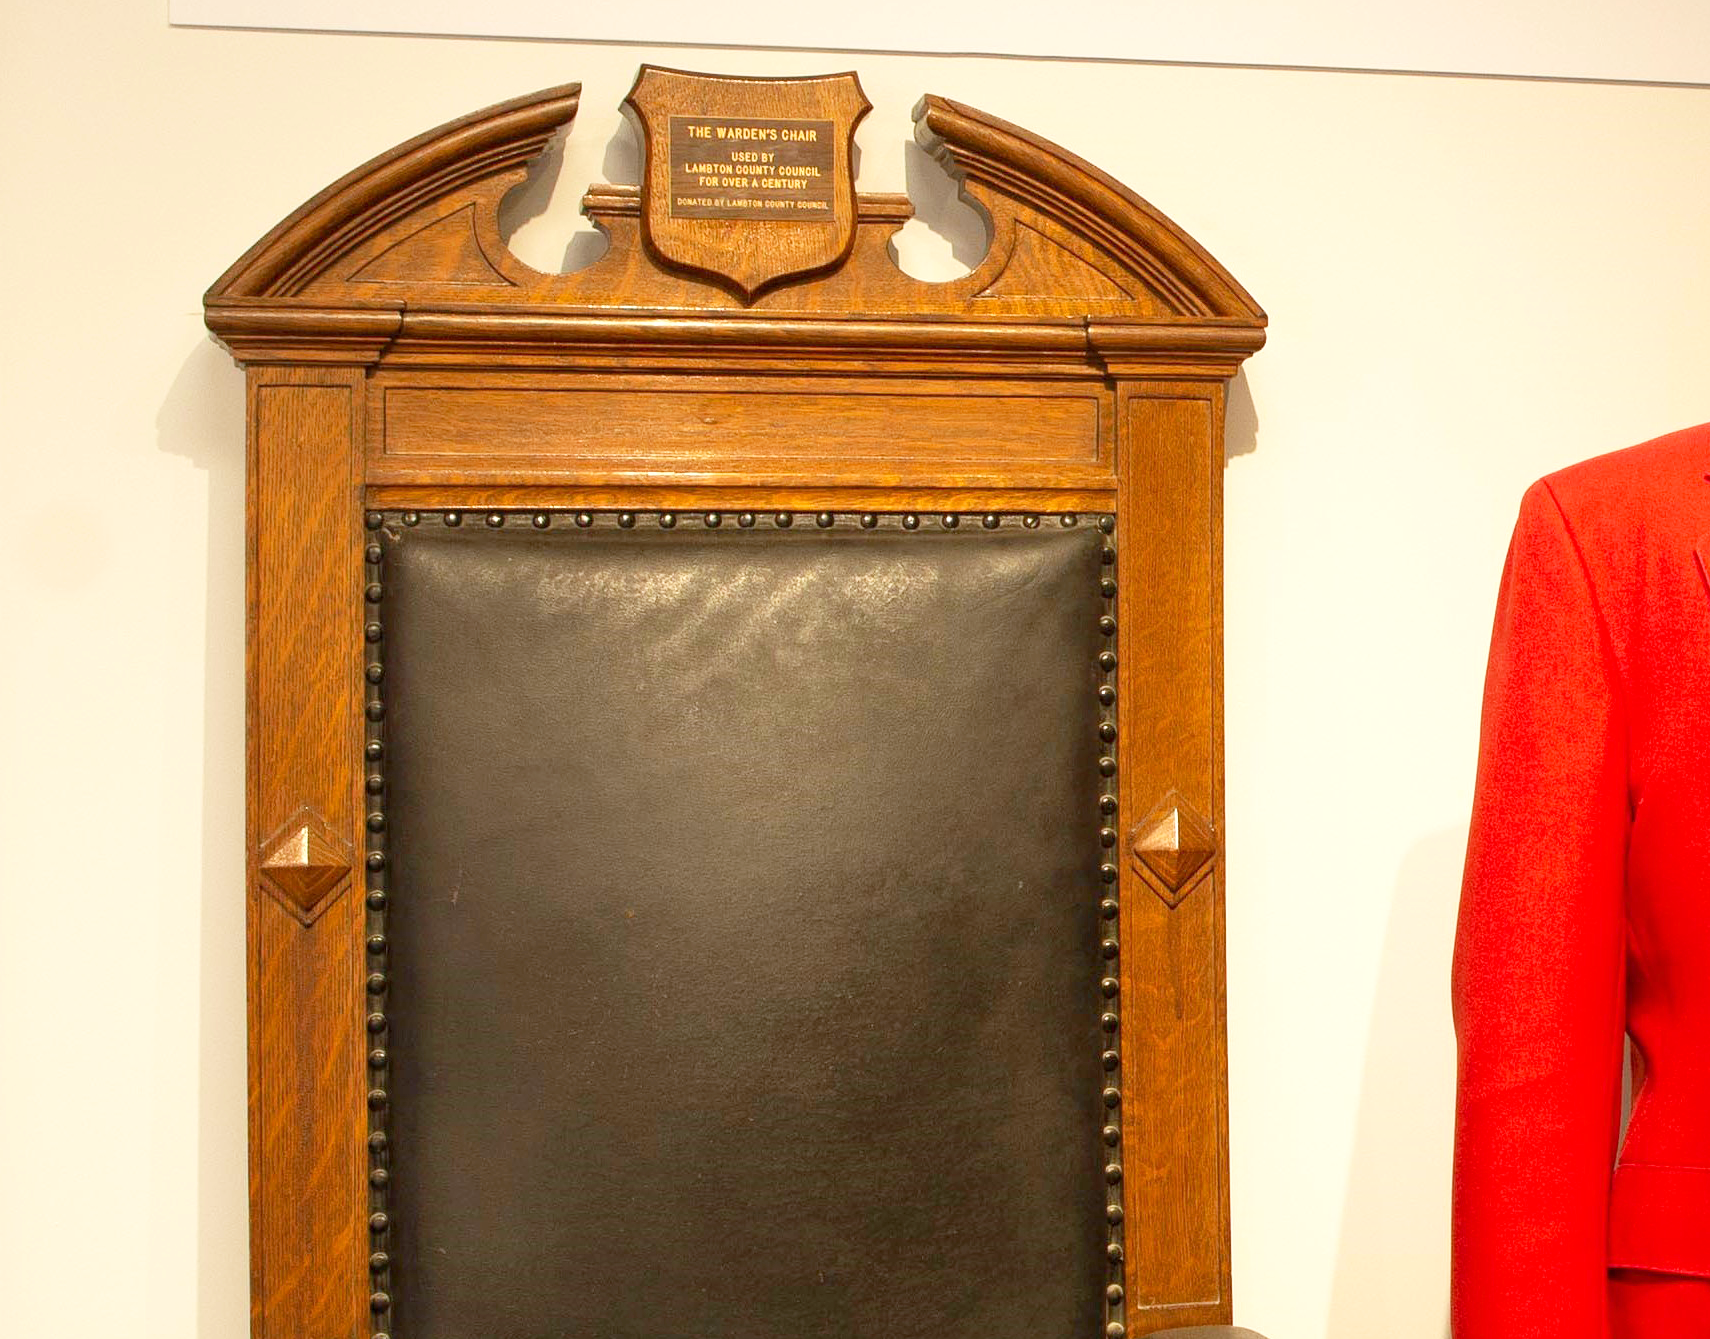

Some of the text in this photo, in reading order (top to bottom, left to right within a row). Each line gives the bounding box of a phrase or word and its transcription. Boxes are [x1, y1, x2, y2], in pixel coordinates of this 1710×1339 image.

[688, 126, 817, 142] THE WARDEN'S CHAIR
[731, 152, 775, 163] USED BY
[685, 163, 821, 177] LAMBTON COUNTY COUNCIL
[699, 176, 808, 190] FOR OVER A CENTURY
